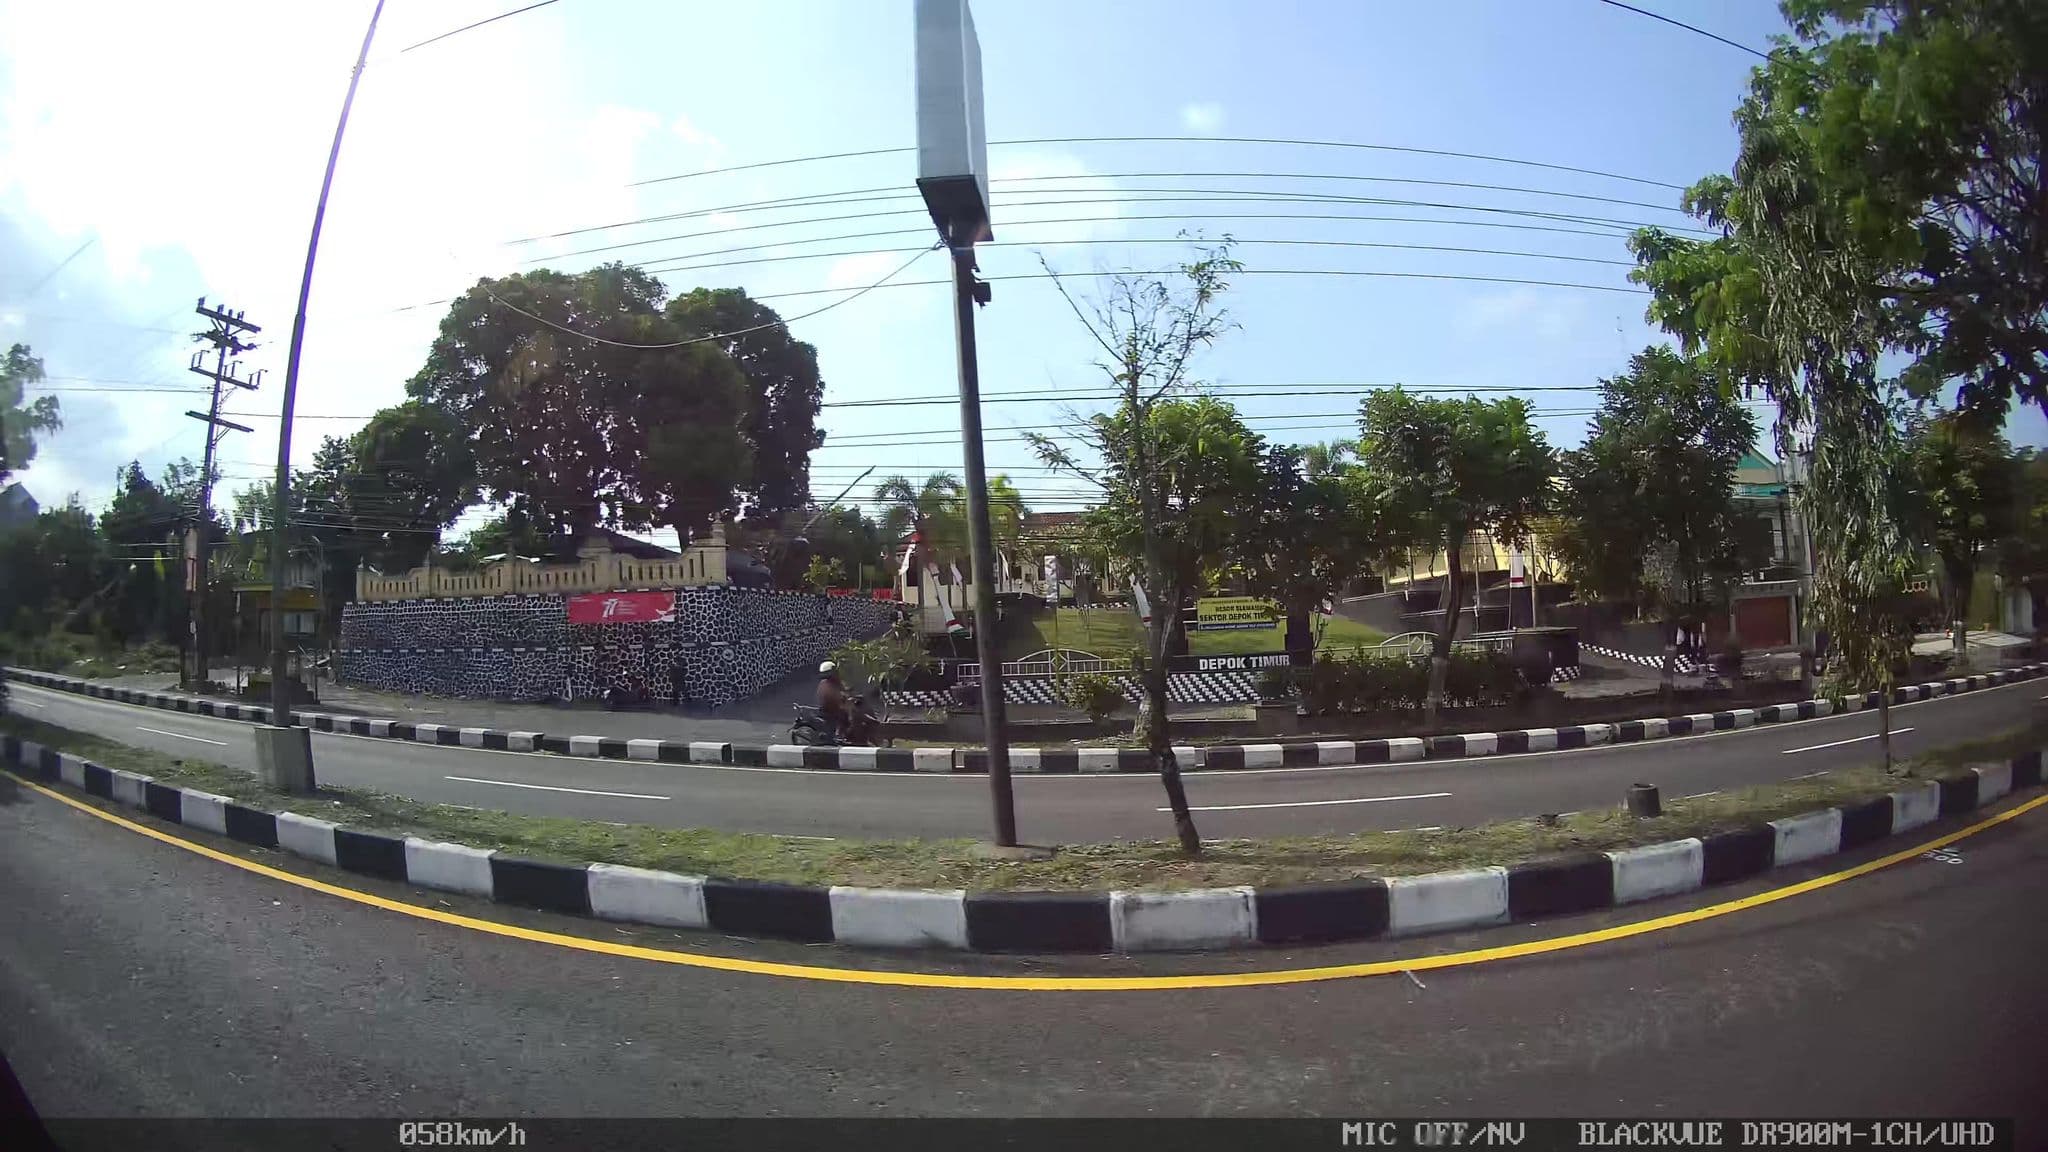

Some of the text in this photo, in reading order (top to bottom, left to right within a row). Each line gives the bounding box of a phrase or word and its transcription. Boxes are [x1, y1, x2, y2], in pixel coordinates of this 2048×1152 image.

[1199, 613, 1227, 622] SEKTOR
[1228, 613, 1252, 621] DEPOK
[1199, 654, 1290, 670] DEPOK TIMUR
